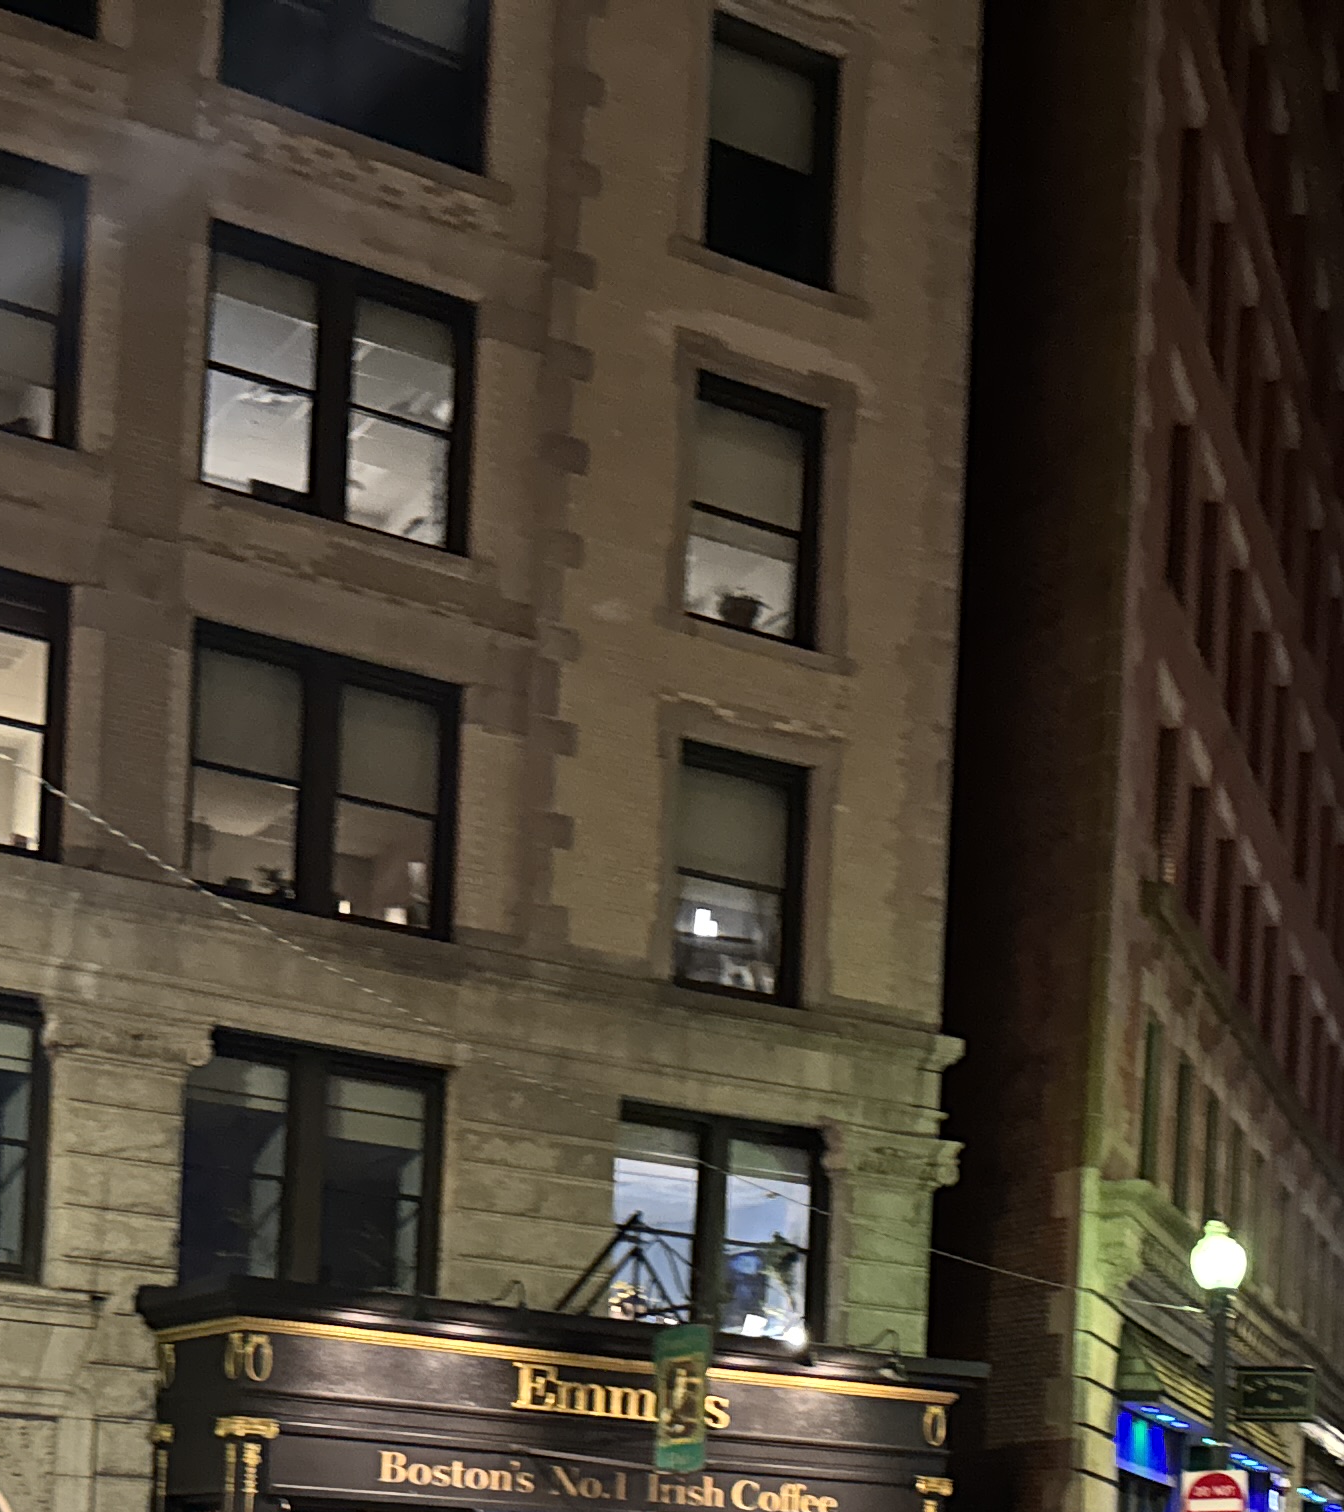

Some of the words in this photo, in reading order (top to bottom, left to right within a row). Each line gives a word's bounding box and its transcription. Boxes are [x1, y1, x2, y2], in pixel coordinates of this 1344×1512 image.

[377, 1450, 535, 1494] Boston's
[648, 1471, 725, 1508] Irish
[1193, 1486, 1213, 1498] DO
[1214, 1485, 1236, 1498] NOT
